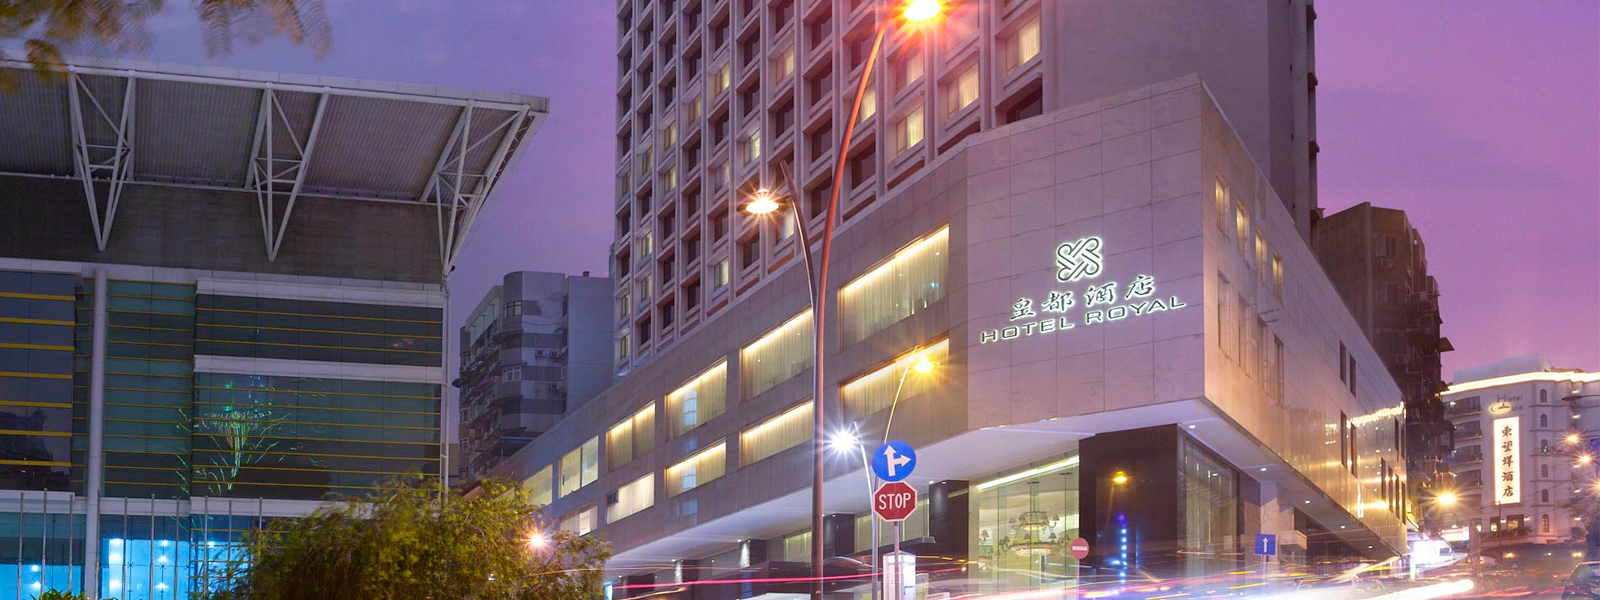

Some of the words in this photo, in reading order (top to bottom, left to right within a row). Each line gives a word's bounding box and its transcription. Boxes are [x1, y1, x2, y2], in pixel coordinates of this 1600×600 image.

[981, 317, 1074, 343] HOTEL
[1086, 296, 1186, 323] ROYAL
[1010, 275, 1155, 321] 皇都酒店
[878, 492, 911, 510] STOP
